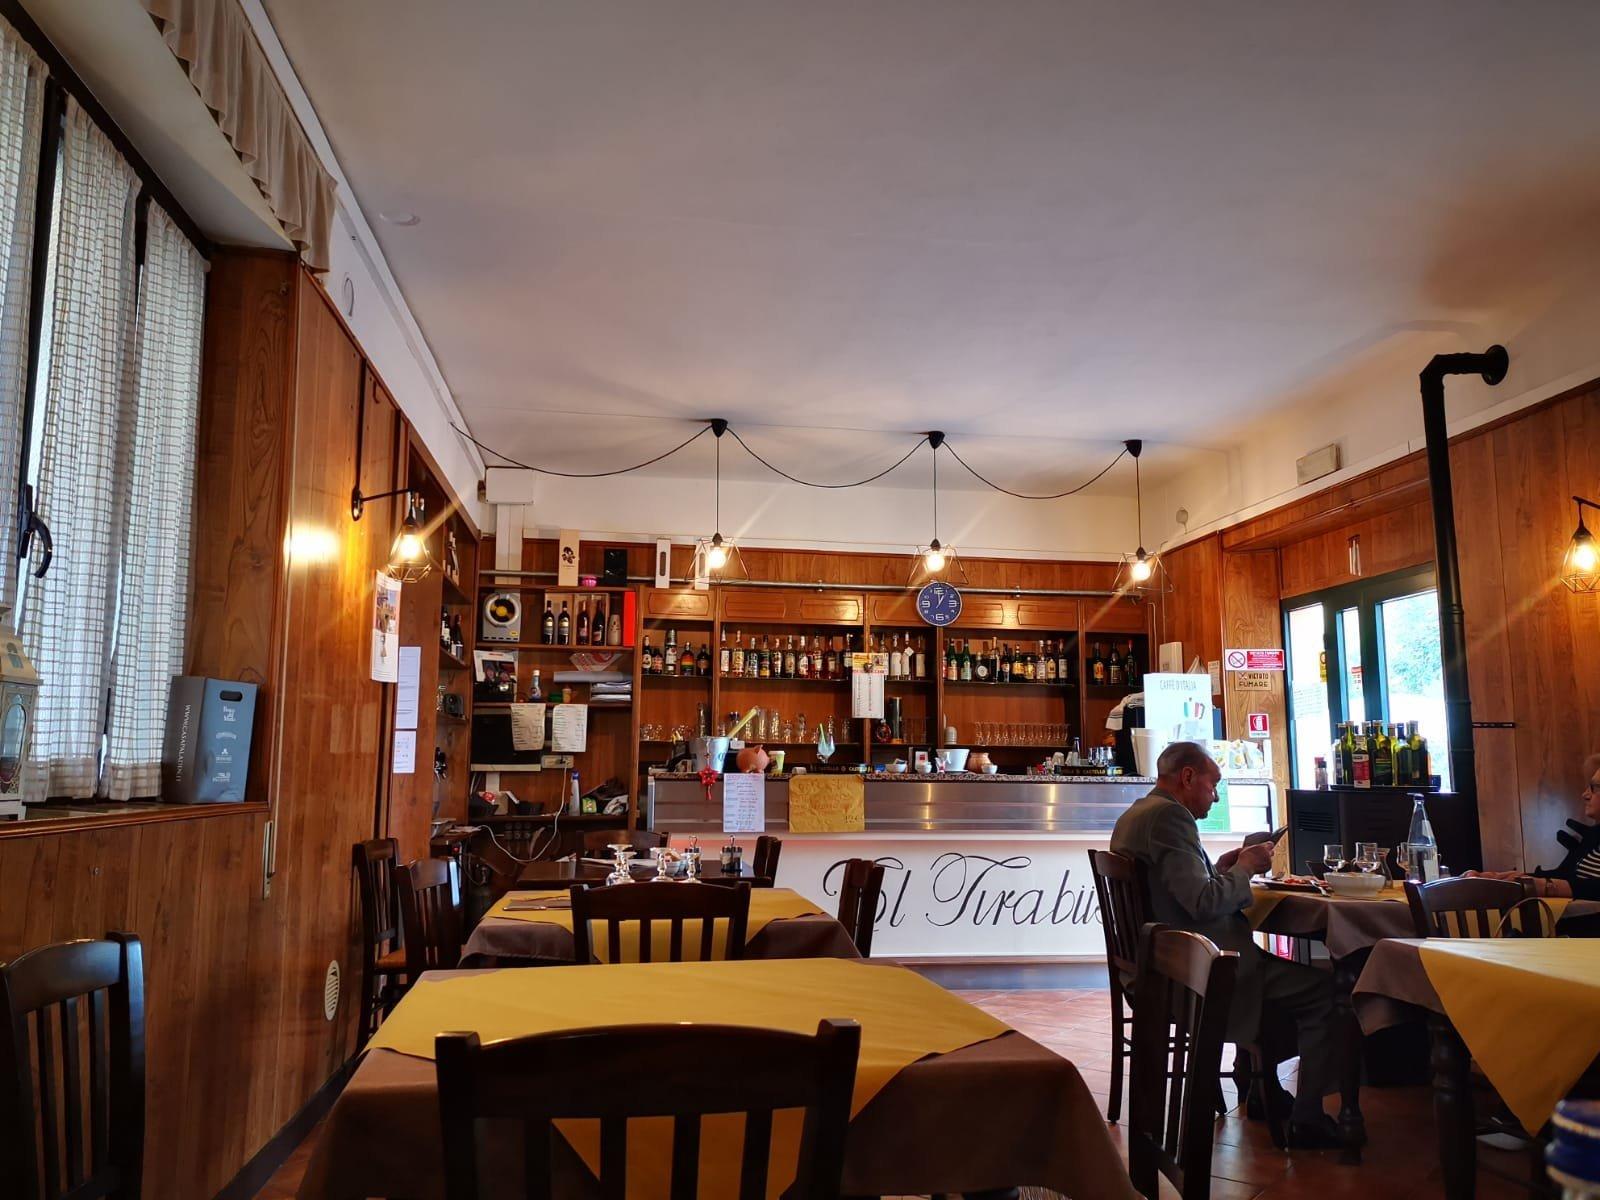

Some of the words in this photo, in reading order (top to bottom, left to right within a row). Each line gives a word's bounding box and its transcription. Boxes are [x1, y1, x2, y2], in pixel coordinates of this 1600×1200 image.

[921, 600, 931, 608] 9
[948, 600, 957, 608] 3
[935, 613, 945, 621] 6
